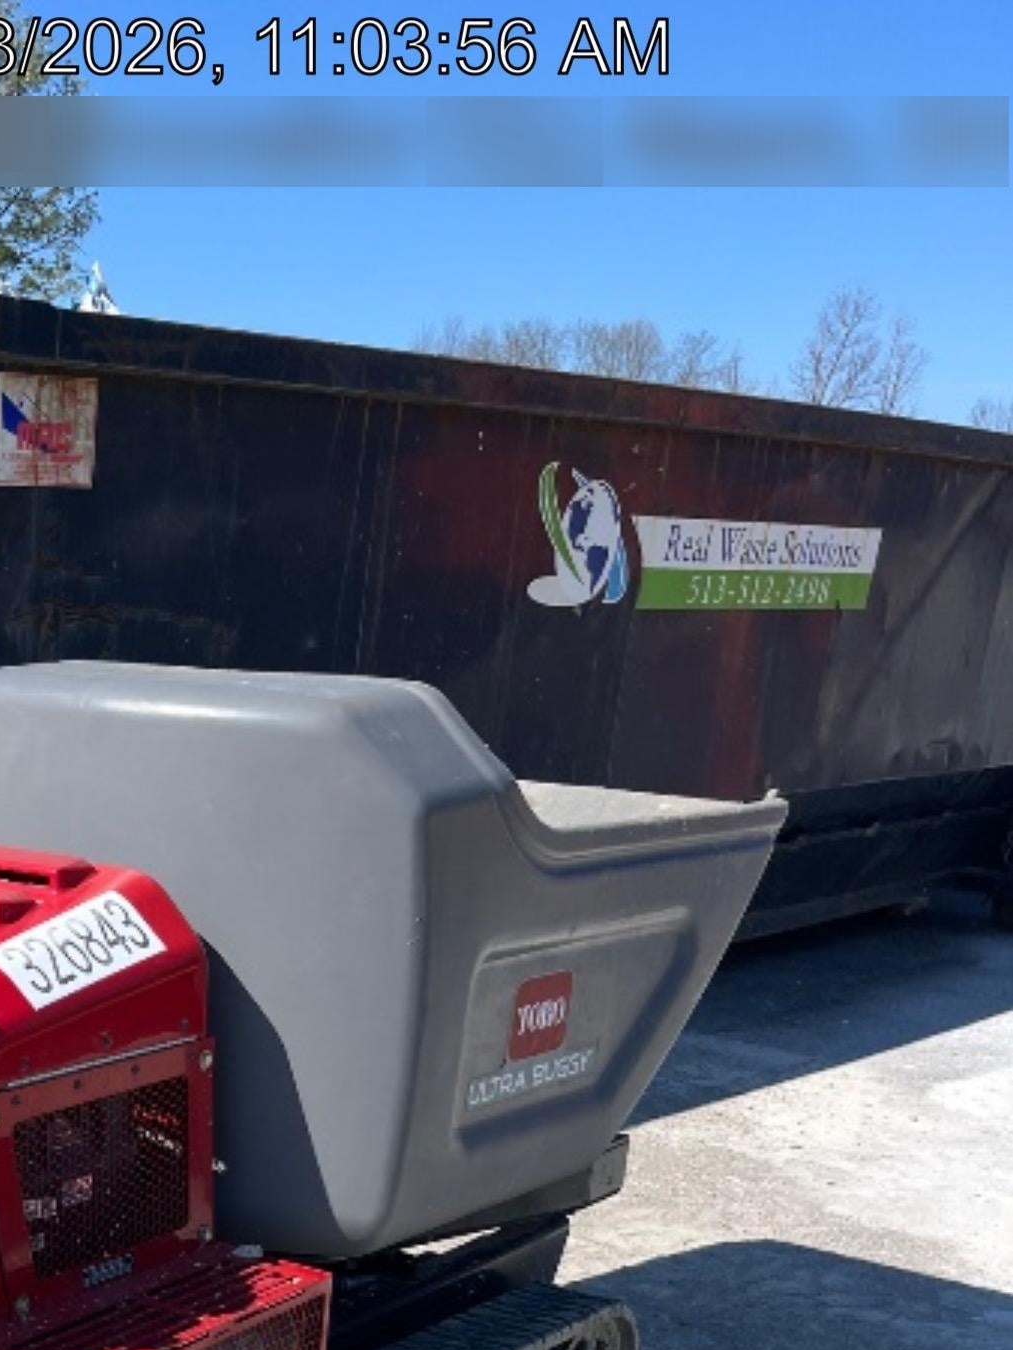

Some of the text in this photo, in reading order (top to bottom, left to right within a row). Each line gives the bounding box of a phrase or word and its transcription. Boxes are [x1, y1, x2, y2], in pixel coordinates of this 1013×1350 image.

[662, 524, 862, 568] Real Waste Solutions
[2, 899, 150, 993] 326843
[517, 996, 566, 1036] TORO
[467, 1049, 596, 1106] ULTRA BUGGY
